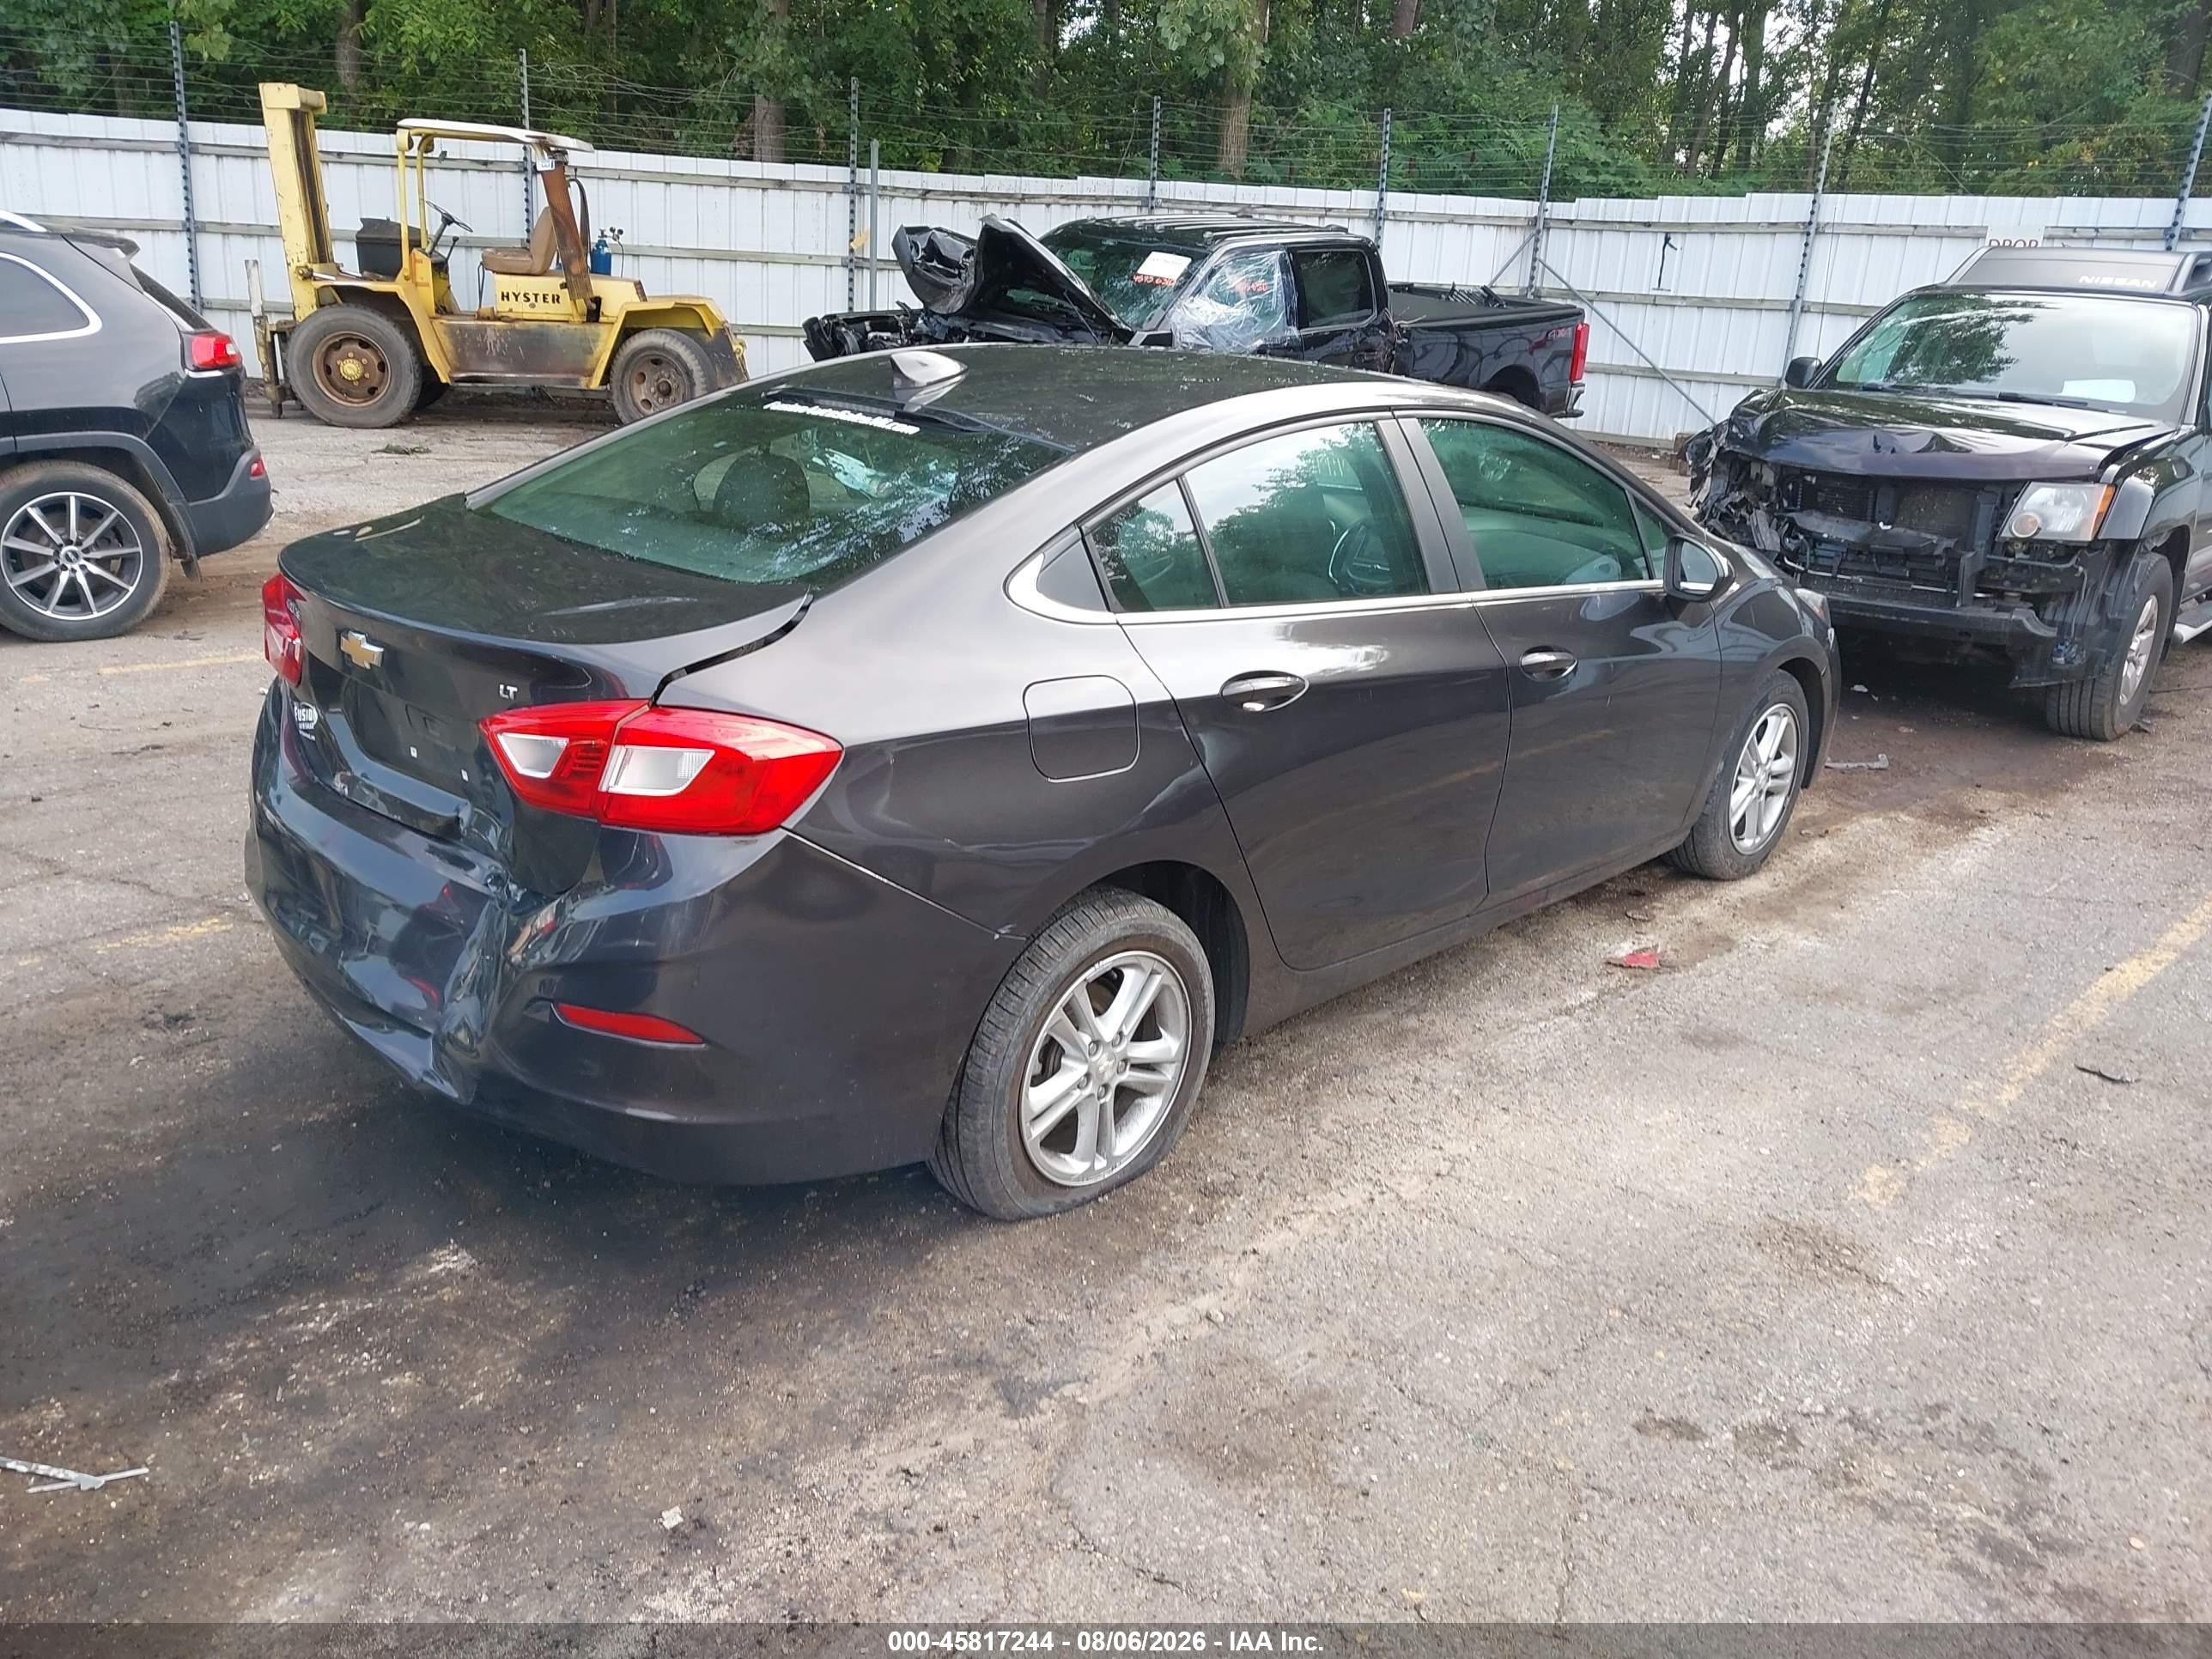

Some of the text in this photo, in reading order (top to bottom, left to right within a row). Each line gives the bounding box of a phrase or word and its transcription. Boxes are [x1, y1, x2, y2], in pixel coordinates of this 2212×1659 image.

[2077, 275, 2158, 289] NISSAN
[501, 291, 561, 304] HYSTER
[499, 684, 518, 701] LT
